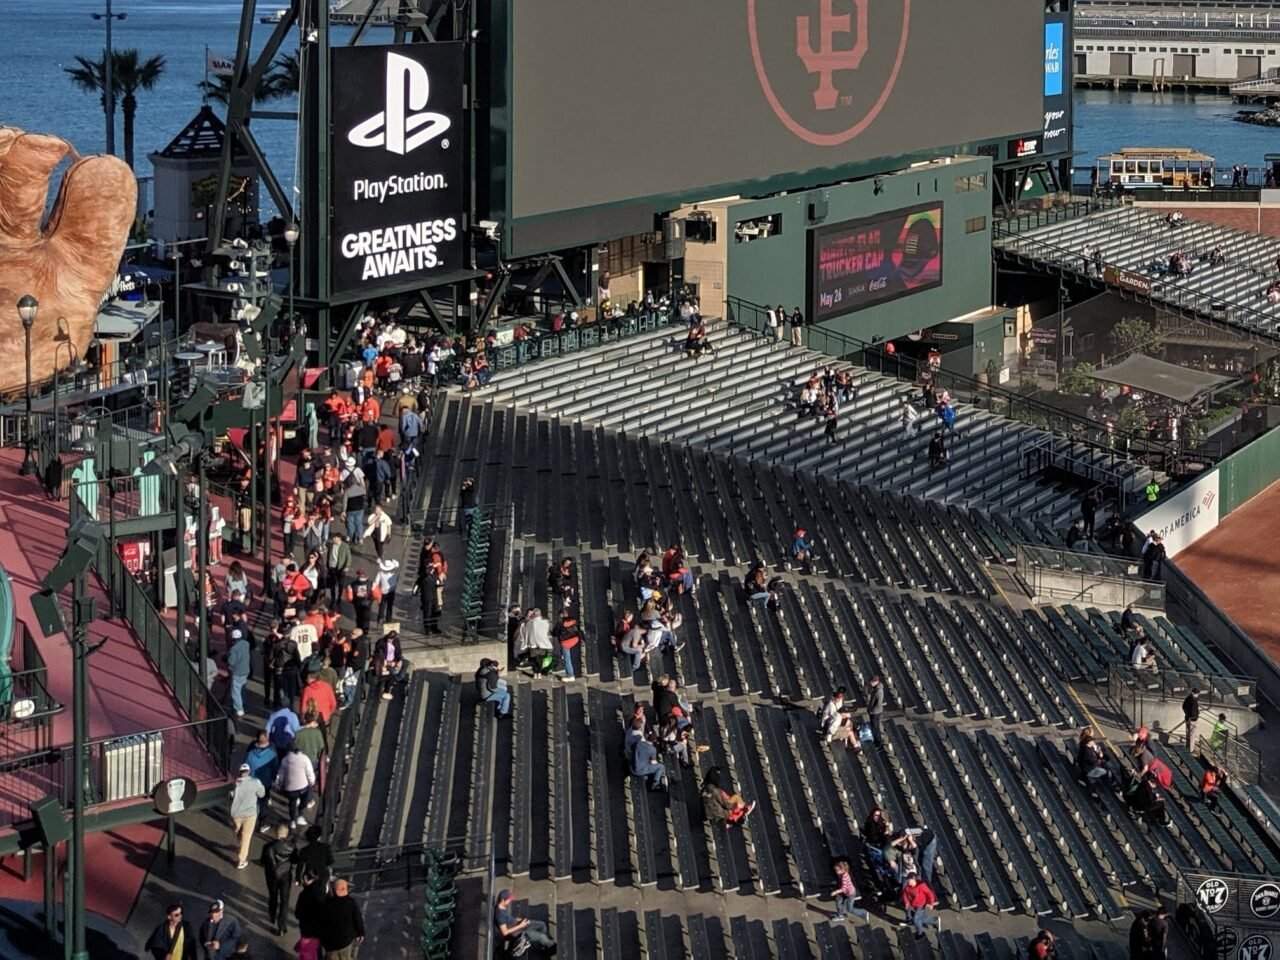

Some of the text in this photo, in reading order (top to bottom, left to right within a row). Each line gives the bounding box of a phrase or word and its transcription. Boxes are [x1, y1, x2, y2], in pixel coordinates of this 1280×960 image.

[341, 217, 456, 259] GREATNESS
[362, 244, 438, 280] AWAITS
[820, 291, 834, 309] May
[1169, 506, 1201, 536] AMERICA
